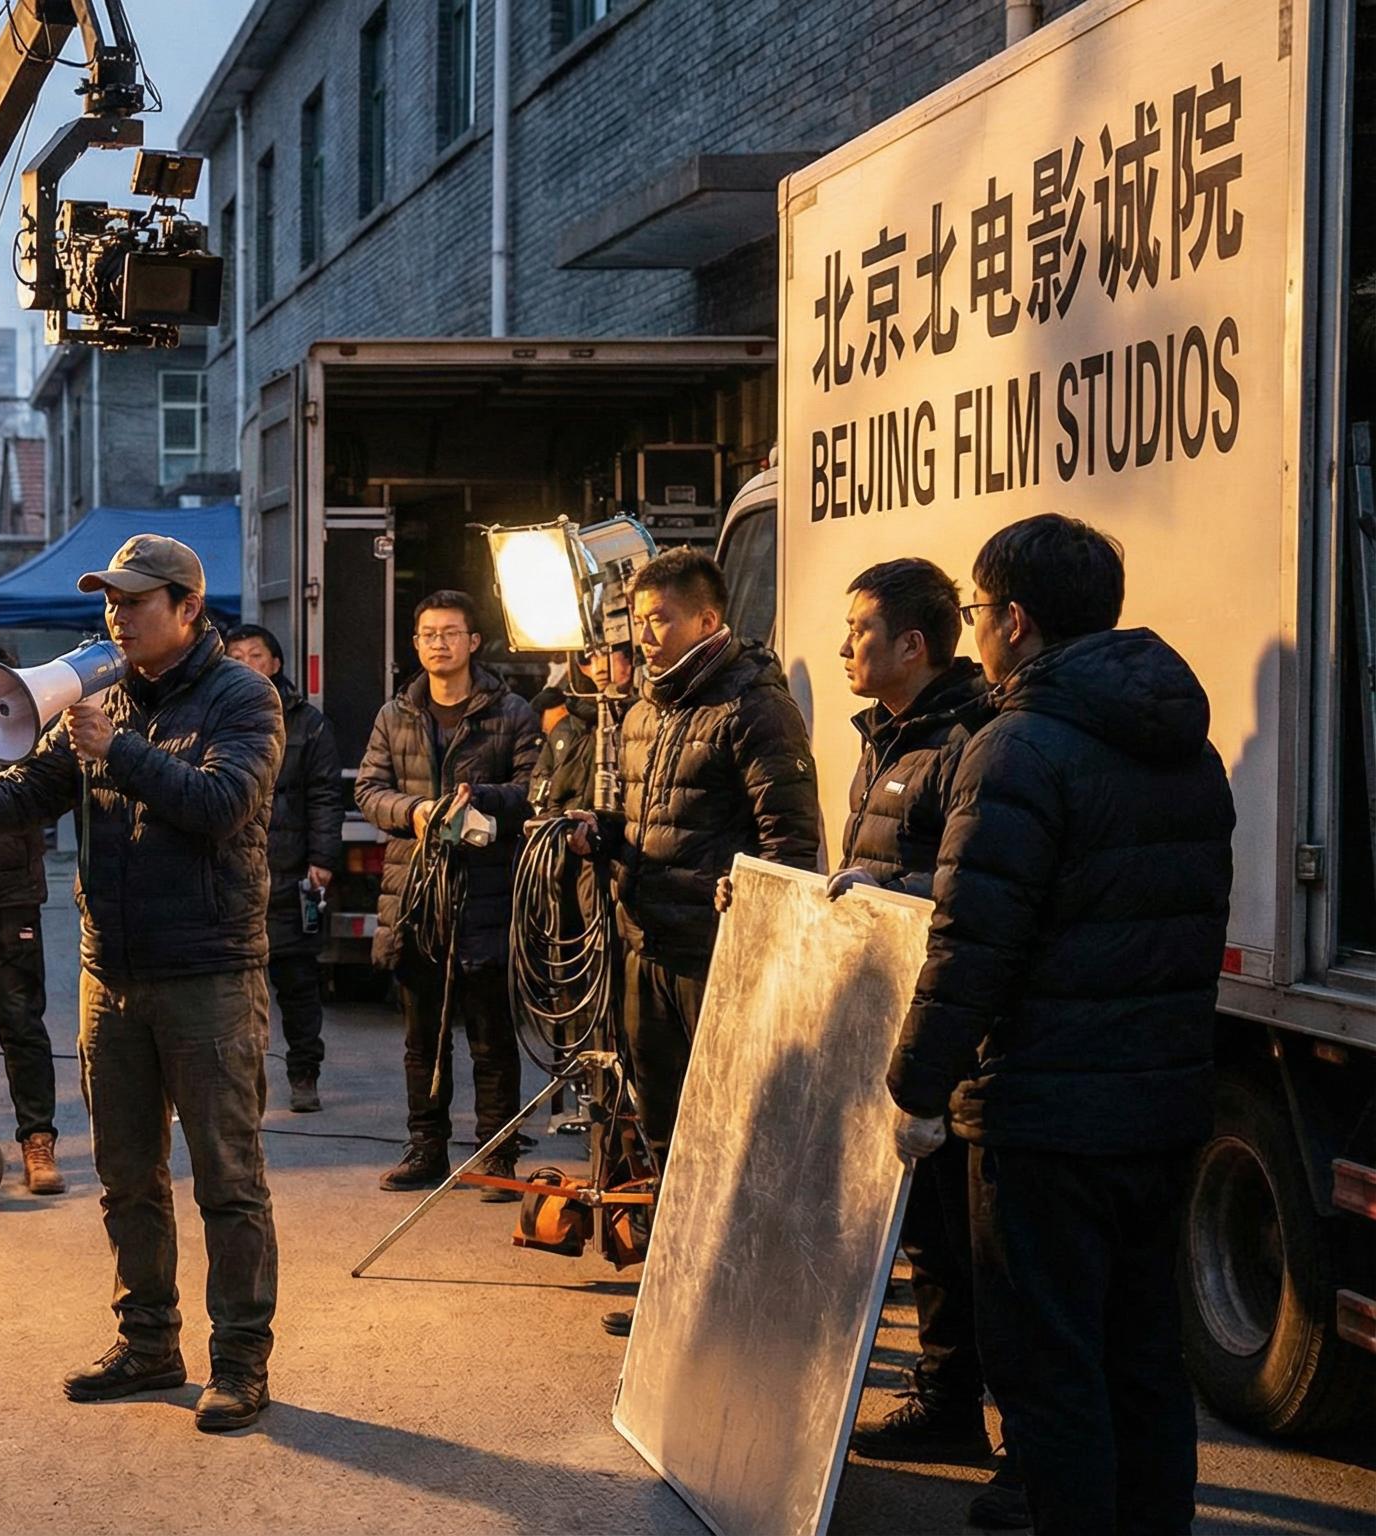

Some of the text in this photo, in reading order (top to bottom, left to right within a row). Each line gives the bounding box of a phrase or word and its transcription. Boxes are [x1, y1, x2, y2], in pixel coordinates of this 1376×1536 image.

[811, 316, 1240, 523] BEIJING FILM STUDIOS
